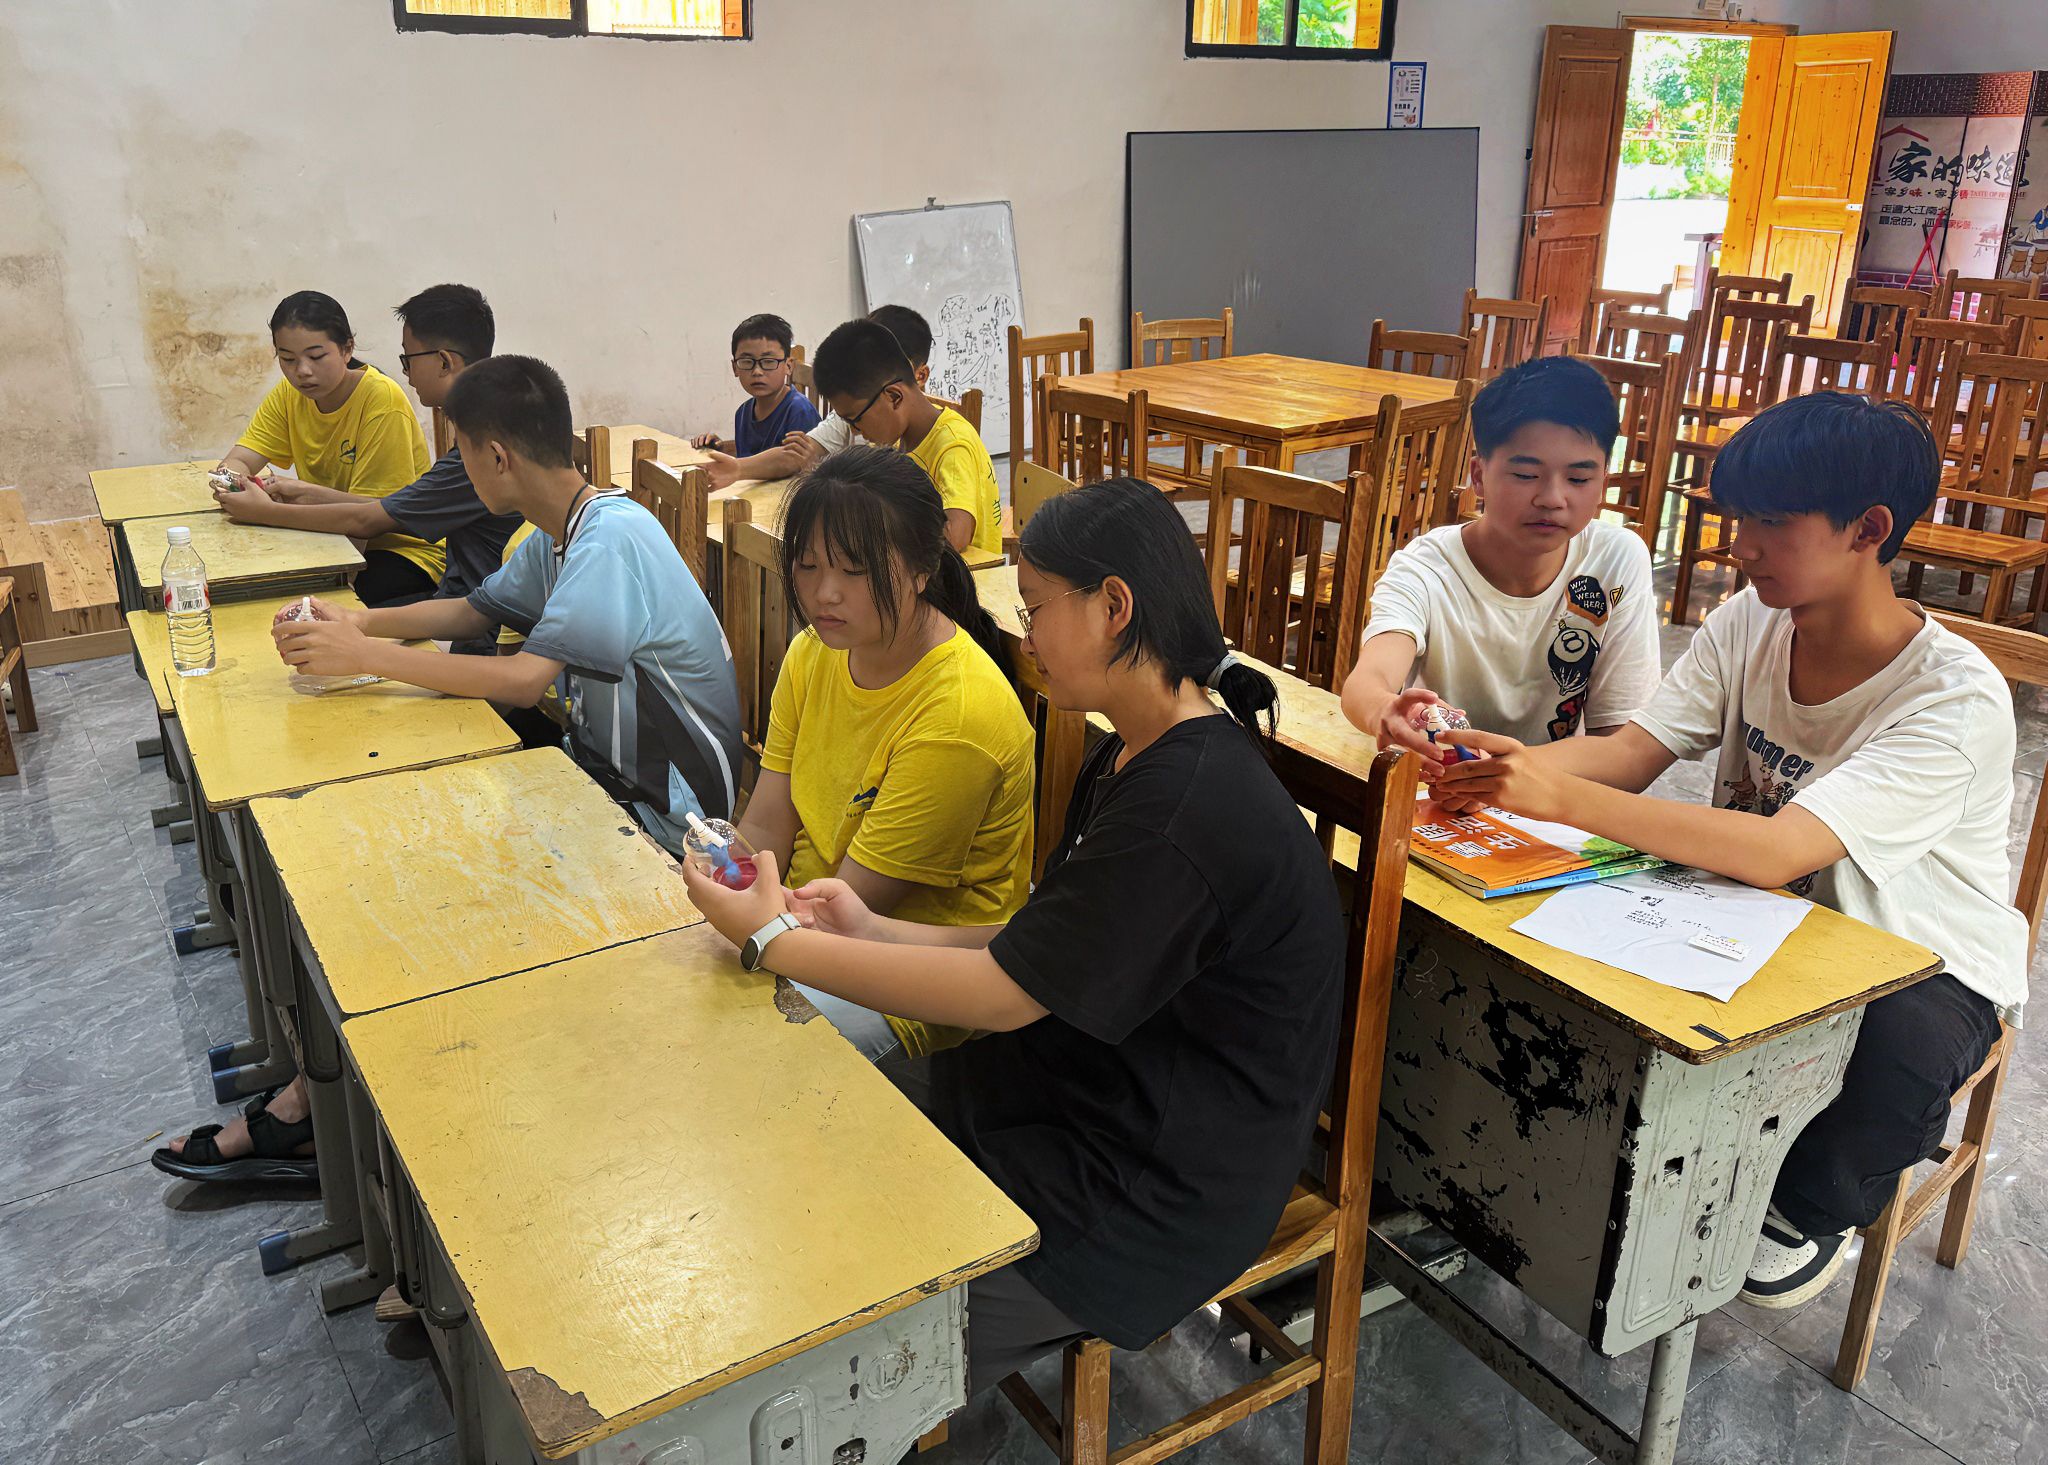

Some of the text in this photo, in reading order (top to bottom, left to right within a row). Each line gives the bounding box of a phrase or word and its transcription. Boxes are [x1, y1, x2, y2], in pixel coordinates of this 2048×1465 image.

[1886, 140, 2030, 188] 家的味道
[1576, 592, 1601, 601] WERE
[1583, 600, 1605, 610] HERE
[1561, 631, 1584, 653] 8
